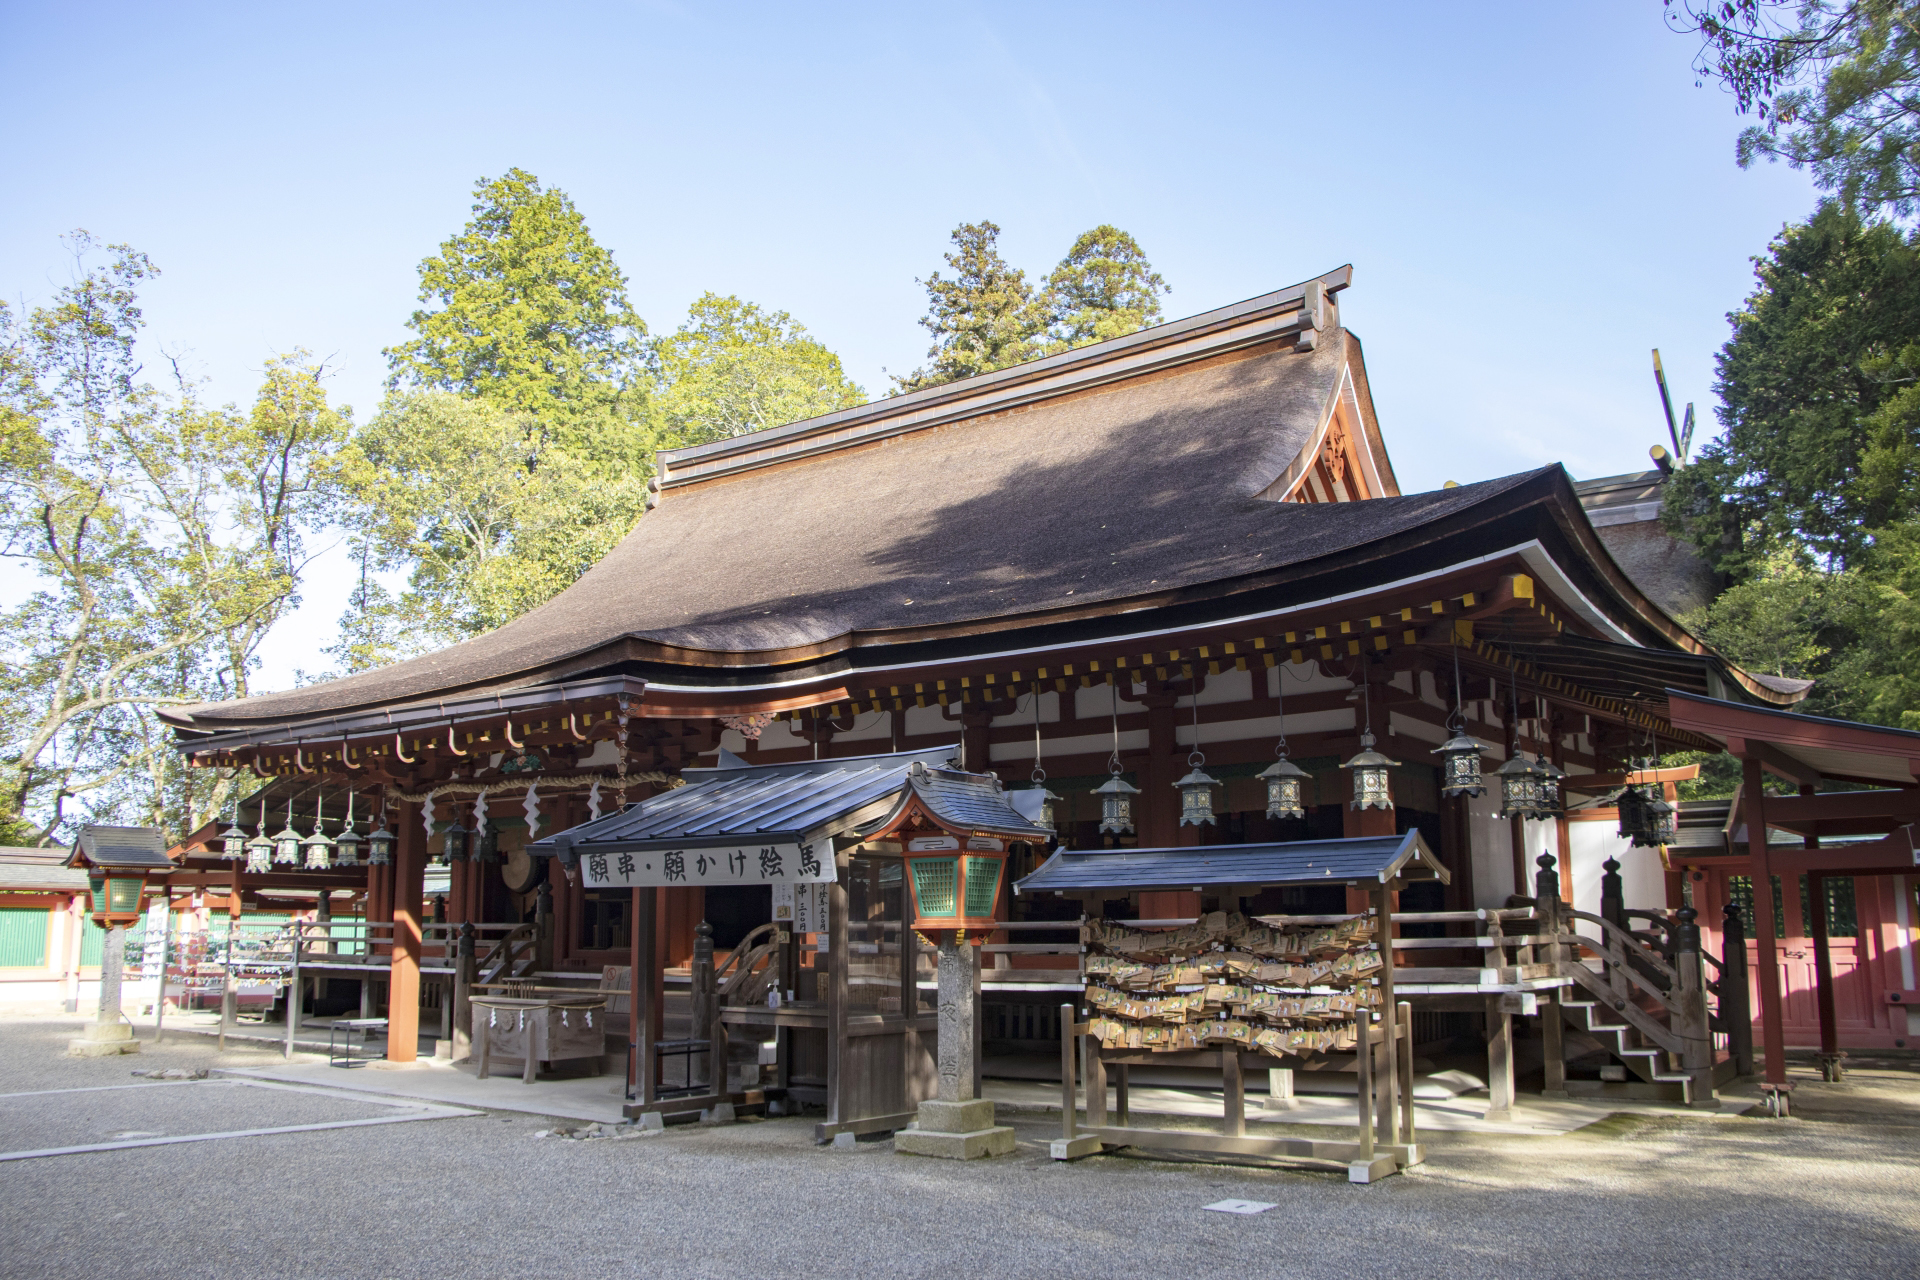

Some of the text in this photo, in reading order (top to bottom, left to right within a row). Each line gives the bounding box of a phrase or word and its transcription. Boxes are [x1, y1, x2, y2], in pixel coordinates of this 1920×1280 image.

[588, 845, 821, 883] 願串・願かけ絵馬
